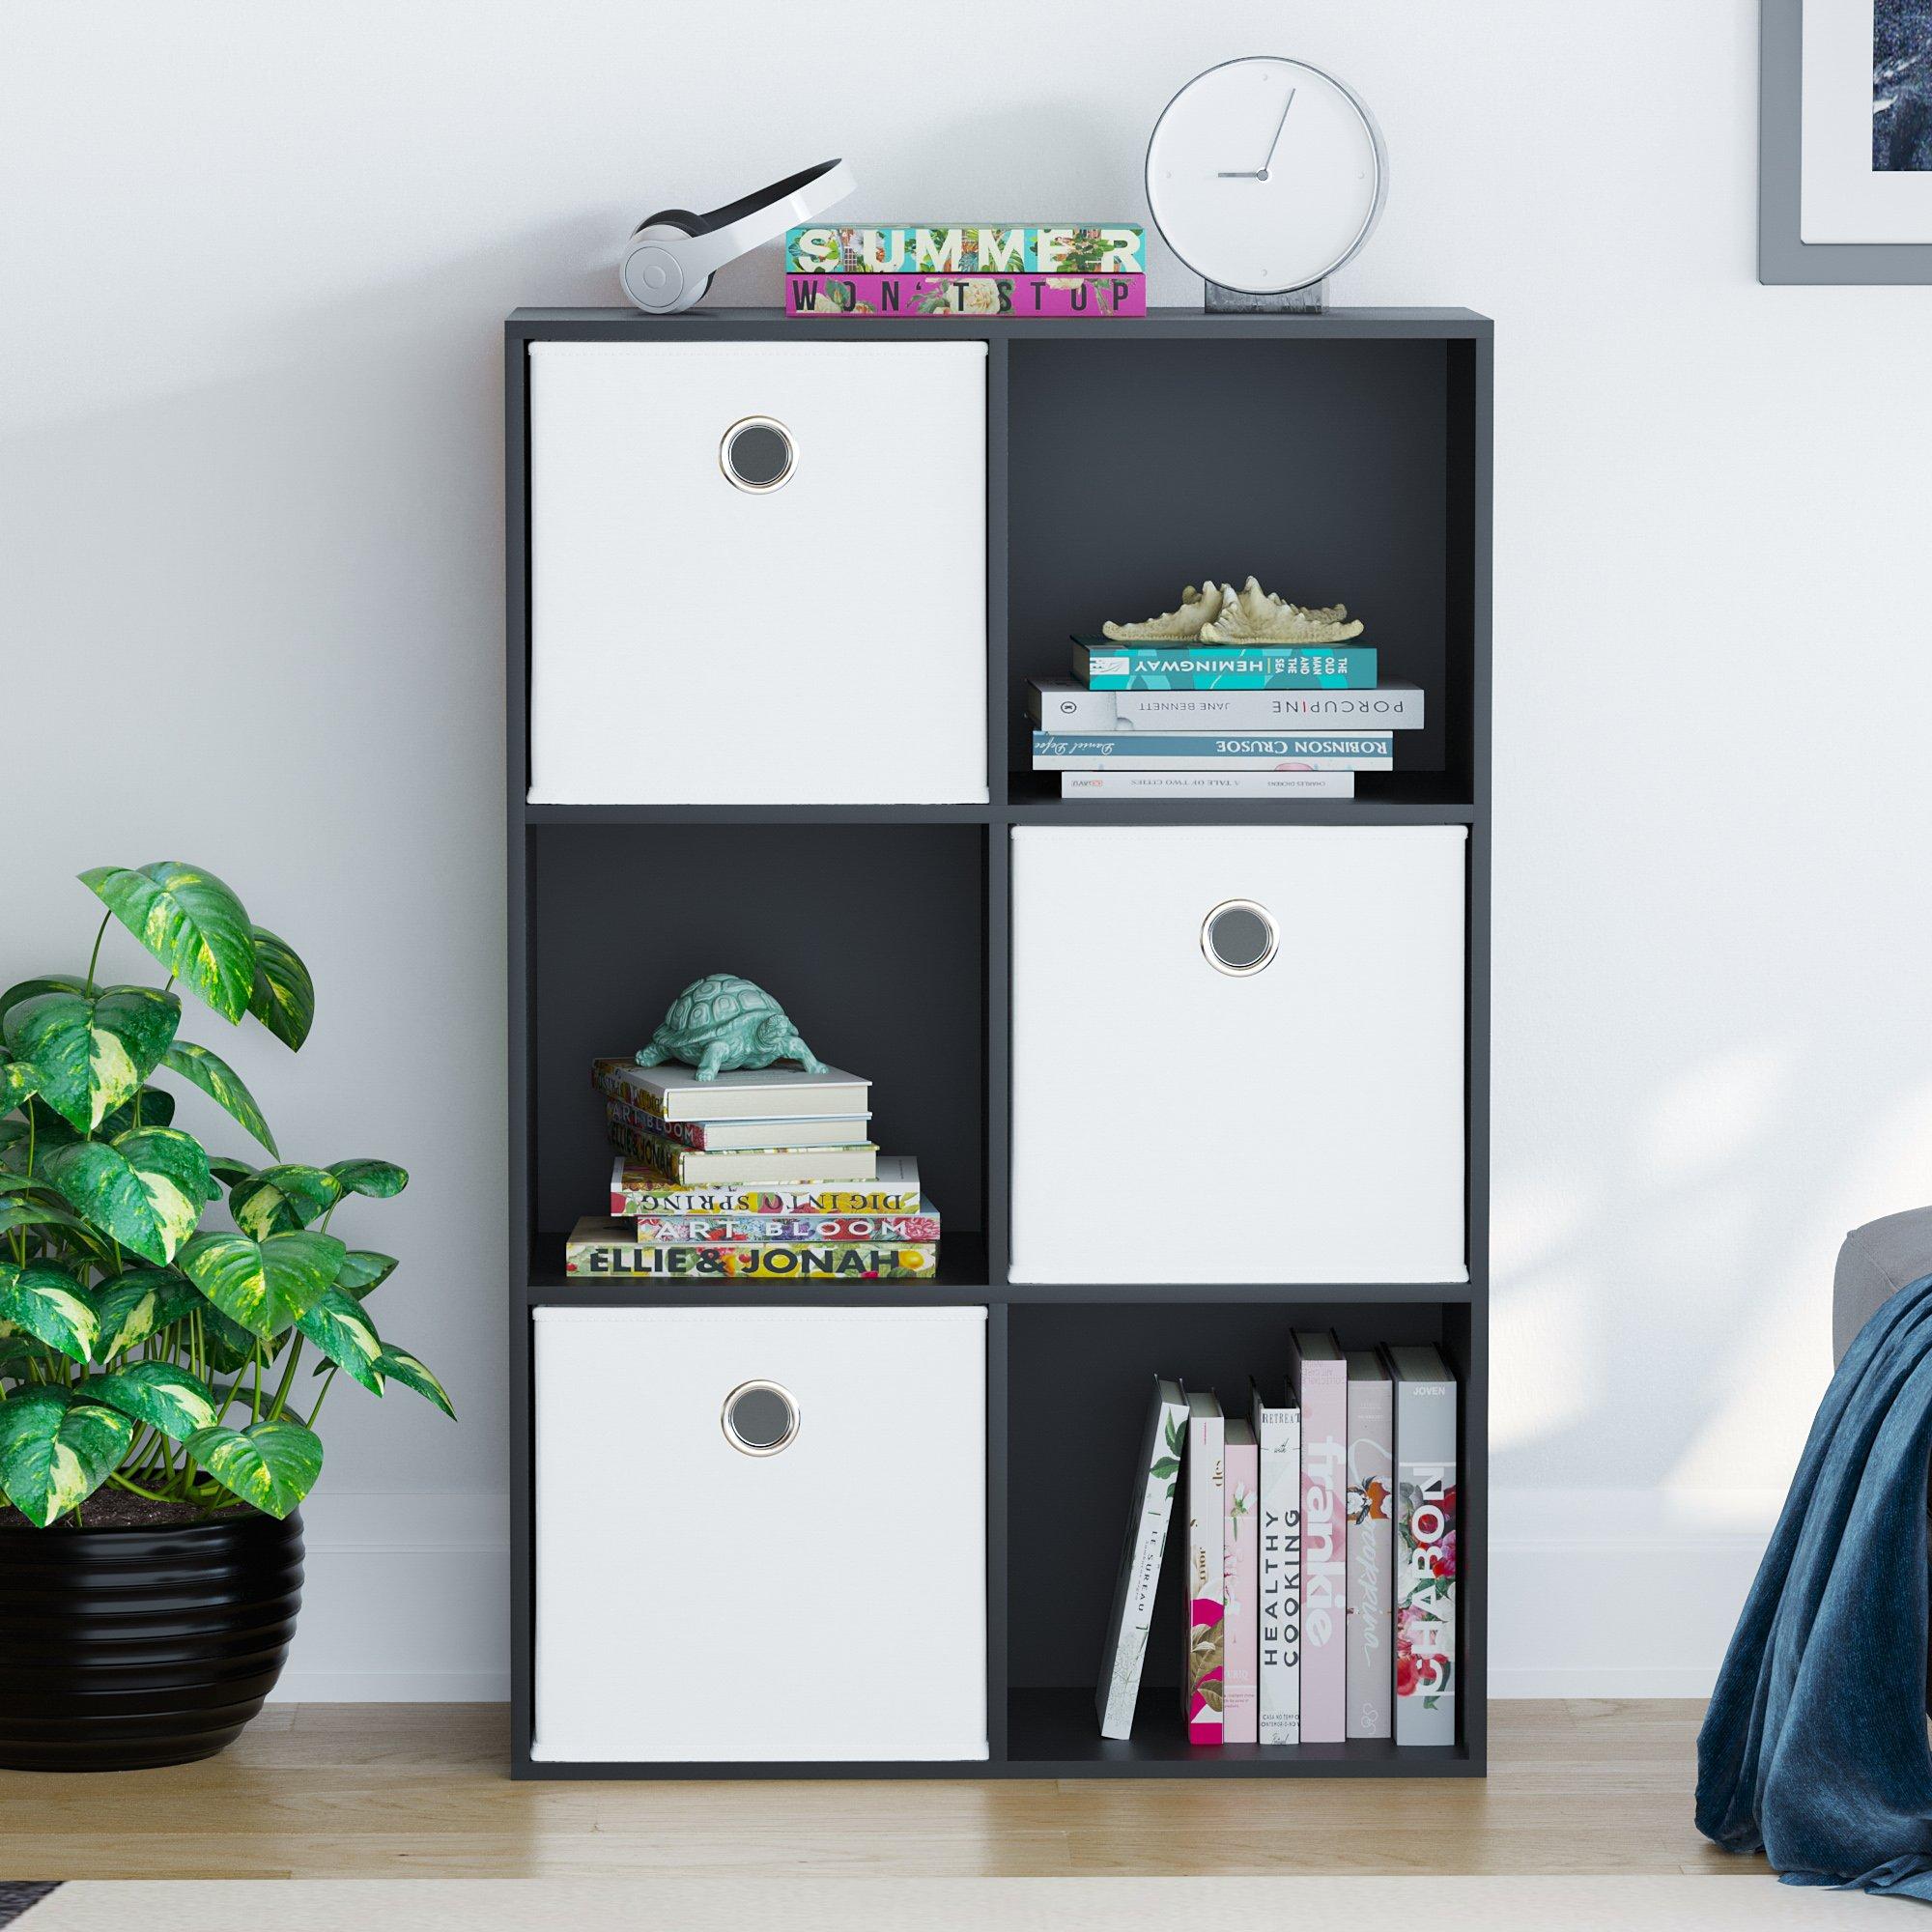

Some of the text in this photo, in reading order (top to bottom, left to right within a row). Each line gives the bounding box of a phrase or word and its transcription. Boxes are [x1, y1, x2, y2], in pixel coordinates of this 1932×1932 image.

[798, 228, 1144, 272] SUMMER
[998, 279, 1129, 312] STOP
[1134, 660, 1264, 672] HEMINGWAY
[1275, 658, 1284, 673] SEA
[1288, 657, 1296, 674] THE
[1300, 656, 1309, 674] AND
[1313, 656, 1321, 674] MAN
[1325, 656, 1335, 673] OLD
[1339, 657, 1348, 674] THE
[1139, 702, 1231, 711] JANE BENNETT
[1271, 700, 1404, 714] PORCUPINE
[1035, 737, 1115, 755] Daniel Defoe
[1216, 740, 1388, 754] ROBINSON CRUSOE
[612, 1104, 694, 1141] ART BLOOM
[640, 1193, 902, 1211] DIG INTO SPRING
[655, 1220, 907, 1239] ART BLOOM
[589, 1246, 900, 1274] ELLIE & JONAH
[1412, 1385, 1446, 1396] JOVEN
[1262, 1412, 1300, 1424] RETREAT
[1149, 1530, 1158, 1546] LE
[1306, 1435, 1347, 1648] frankie
[1137, 1552, 1155, 1612] SUREAU
[1264, 1511, 1280, 1666] HEALTHY
[1283, 1509, 1300, 1667] COOKING
[1411, 1466, 1447, 1694] CHABON
